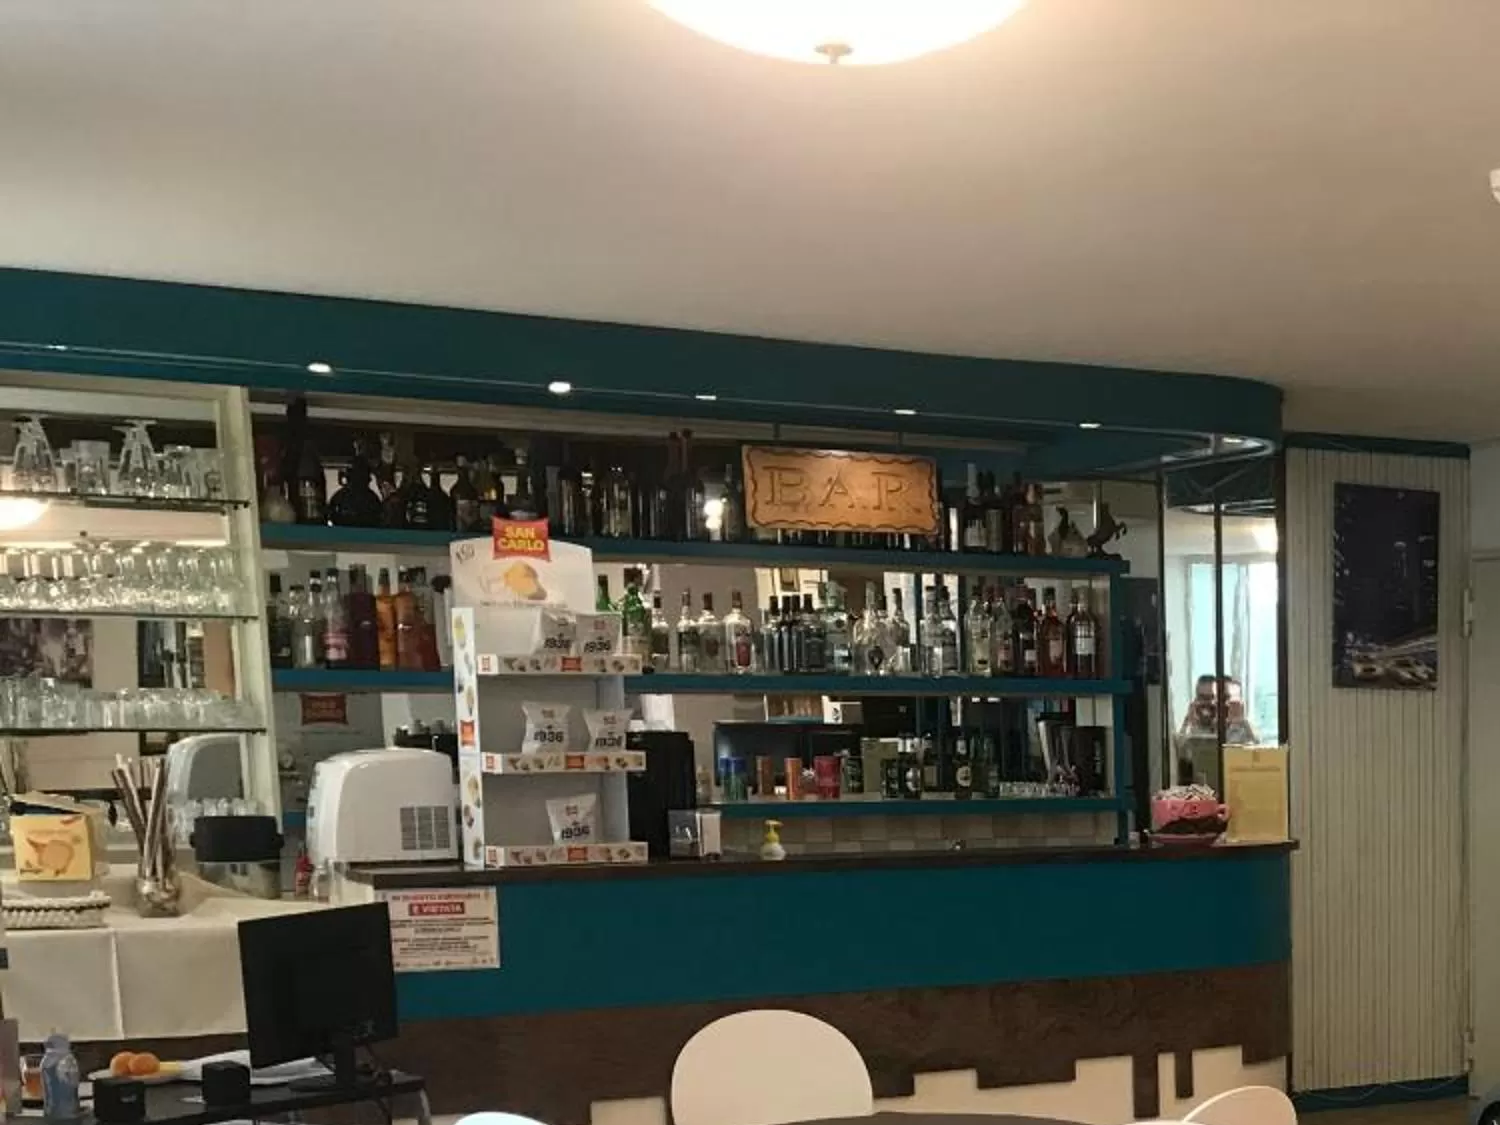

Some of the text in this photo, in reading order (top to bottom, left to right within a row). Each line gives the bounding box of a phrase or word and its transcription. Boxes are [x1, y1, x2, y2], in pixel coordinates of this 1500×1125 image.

[761, 465, 923, 513] BAR
[504, 527, 536, 539] SAN
[498, 538, 545, 552] CARLO
